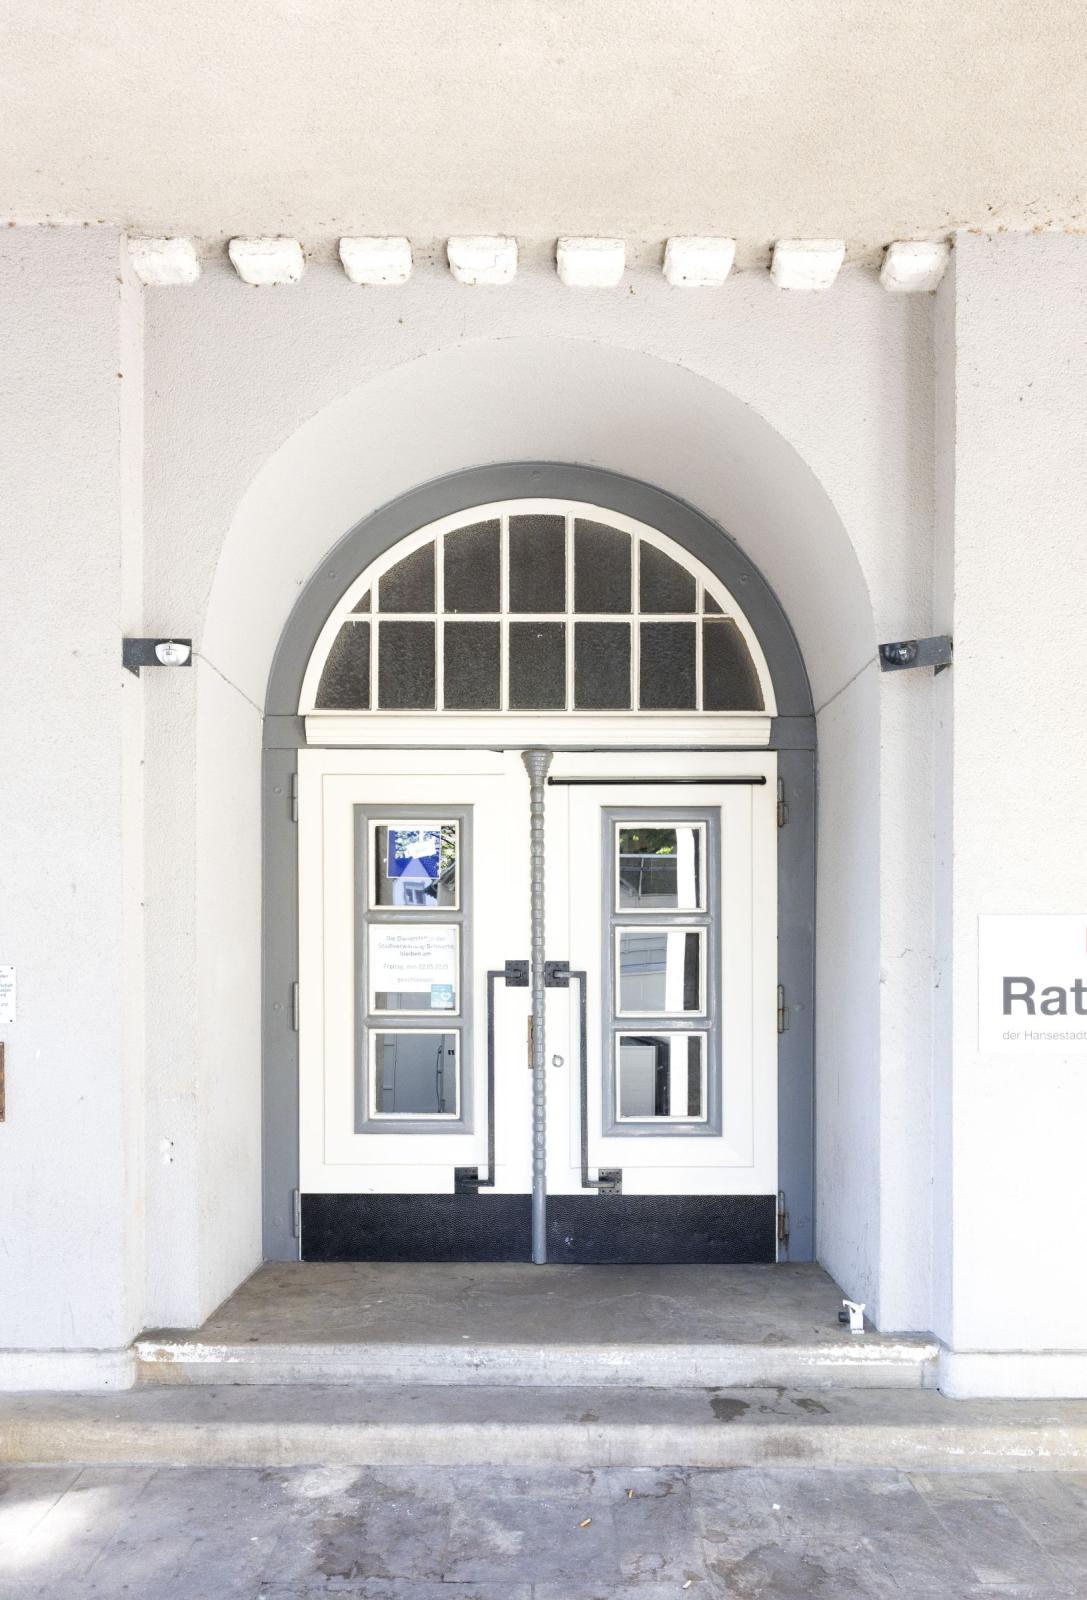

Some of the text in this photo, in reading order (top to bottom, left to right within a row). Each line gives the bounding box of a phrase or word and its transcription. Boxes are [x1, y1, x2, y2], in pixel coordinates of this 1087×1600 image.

[1003, 976, 1087, 1016] Rat
[1002, 1029, 1087, 1040] der Hansestadt
